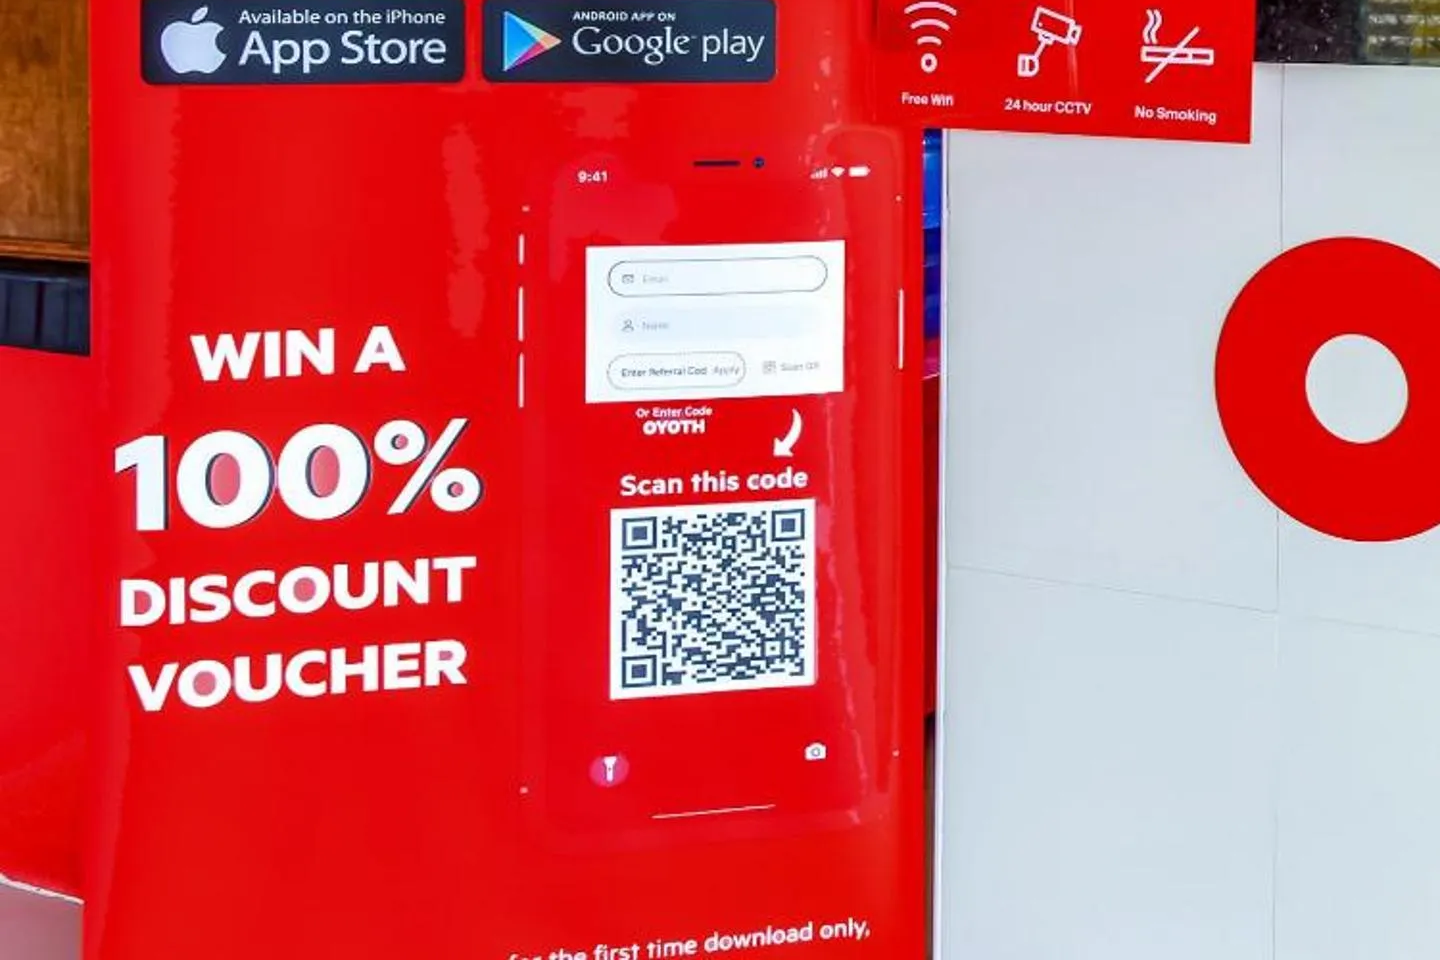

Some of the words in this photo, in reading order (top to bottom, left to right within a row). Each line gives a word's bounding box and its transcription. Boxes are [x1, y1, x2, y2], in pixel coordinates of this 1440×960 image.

[238, 9, 321, 25] Available
[324, 13, 348, 24] on
[353, 10, 382, 24] the
[385, 9, 446, 25] iPhone
[572, 10, 629, 22] ANDROID
[631, 11, 655, 22] APP
[657, 11, 677, 22] ON
[238, 30, 331, 74] App
[340, 30, 447, 65] Store
[572, 26, 690, 66] Google
[702, 28, 765, 63] play
[901, 91, 929, 105] Free
[1004, 97, 1021, 111] 24
[1022, 99, 1053, 113] hour
[1054, 100, 1092, 115] CCTV
[1134, 105, 1155, 119] No
[1156, 106, 1217, 126] Smoking
[577, 170, 608, 184] 9:41
[190, 327, 335, 382] WIN
[353, 325, 406, 374] A
[635, 407, 650, 419] Or
[652, 406, 683, 418] Enter
[685, 405, 713, 417] Code
[642, 419, 706, 436] OYOTH
[114, 417, 484, 532] 100%
[620, 474, 684, 497] Scan
[690, 470, 740, 493] this
[746, 466, 809, 491] code
[120, 555, 477, 627] DISCOUNT
[127, 639, 468, 712] VOUCHER
[593, 943, 641, 960] first
[646, 937, 698, 960] time
[703, 921, 813, 953] download
